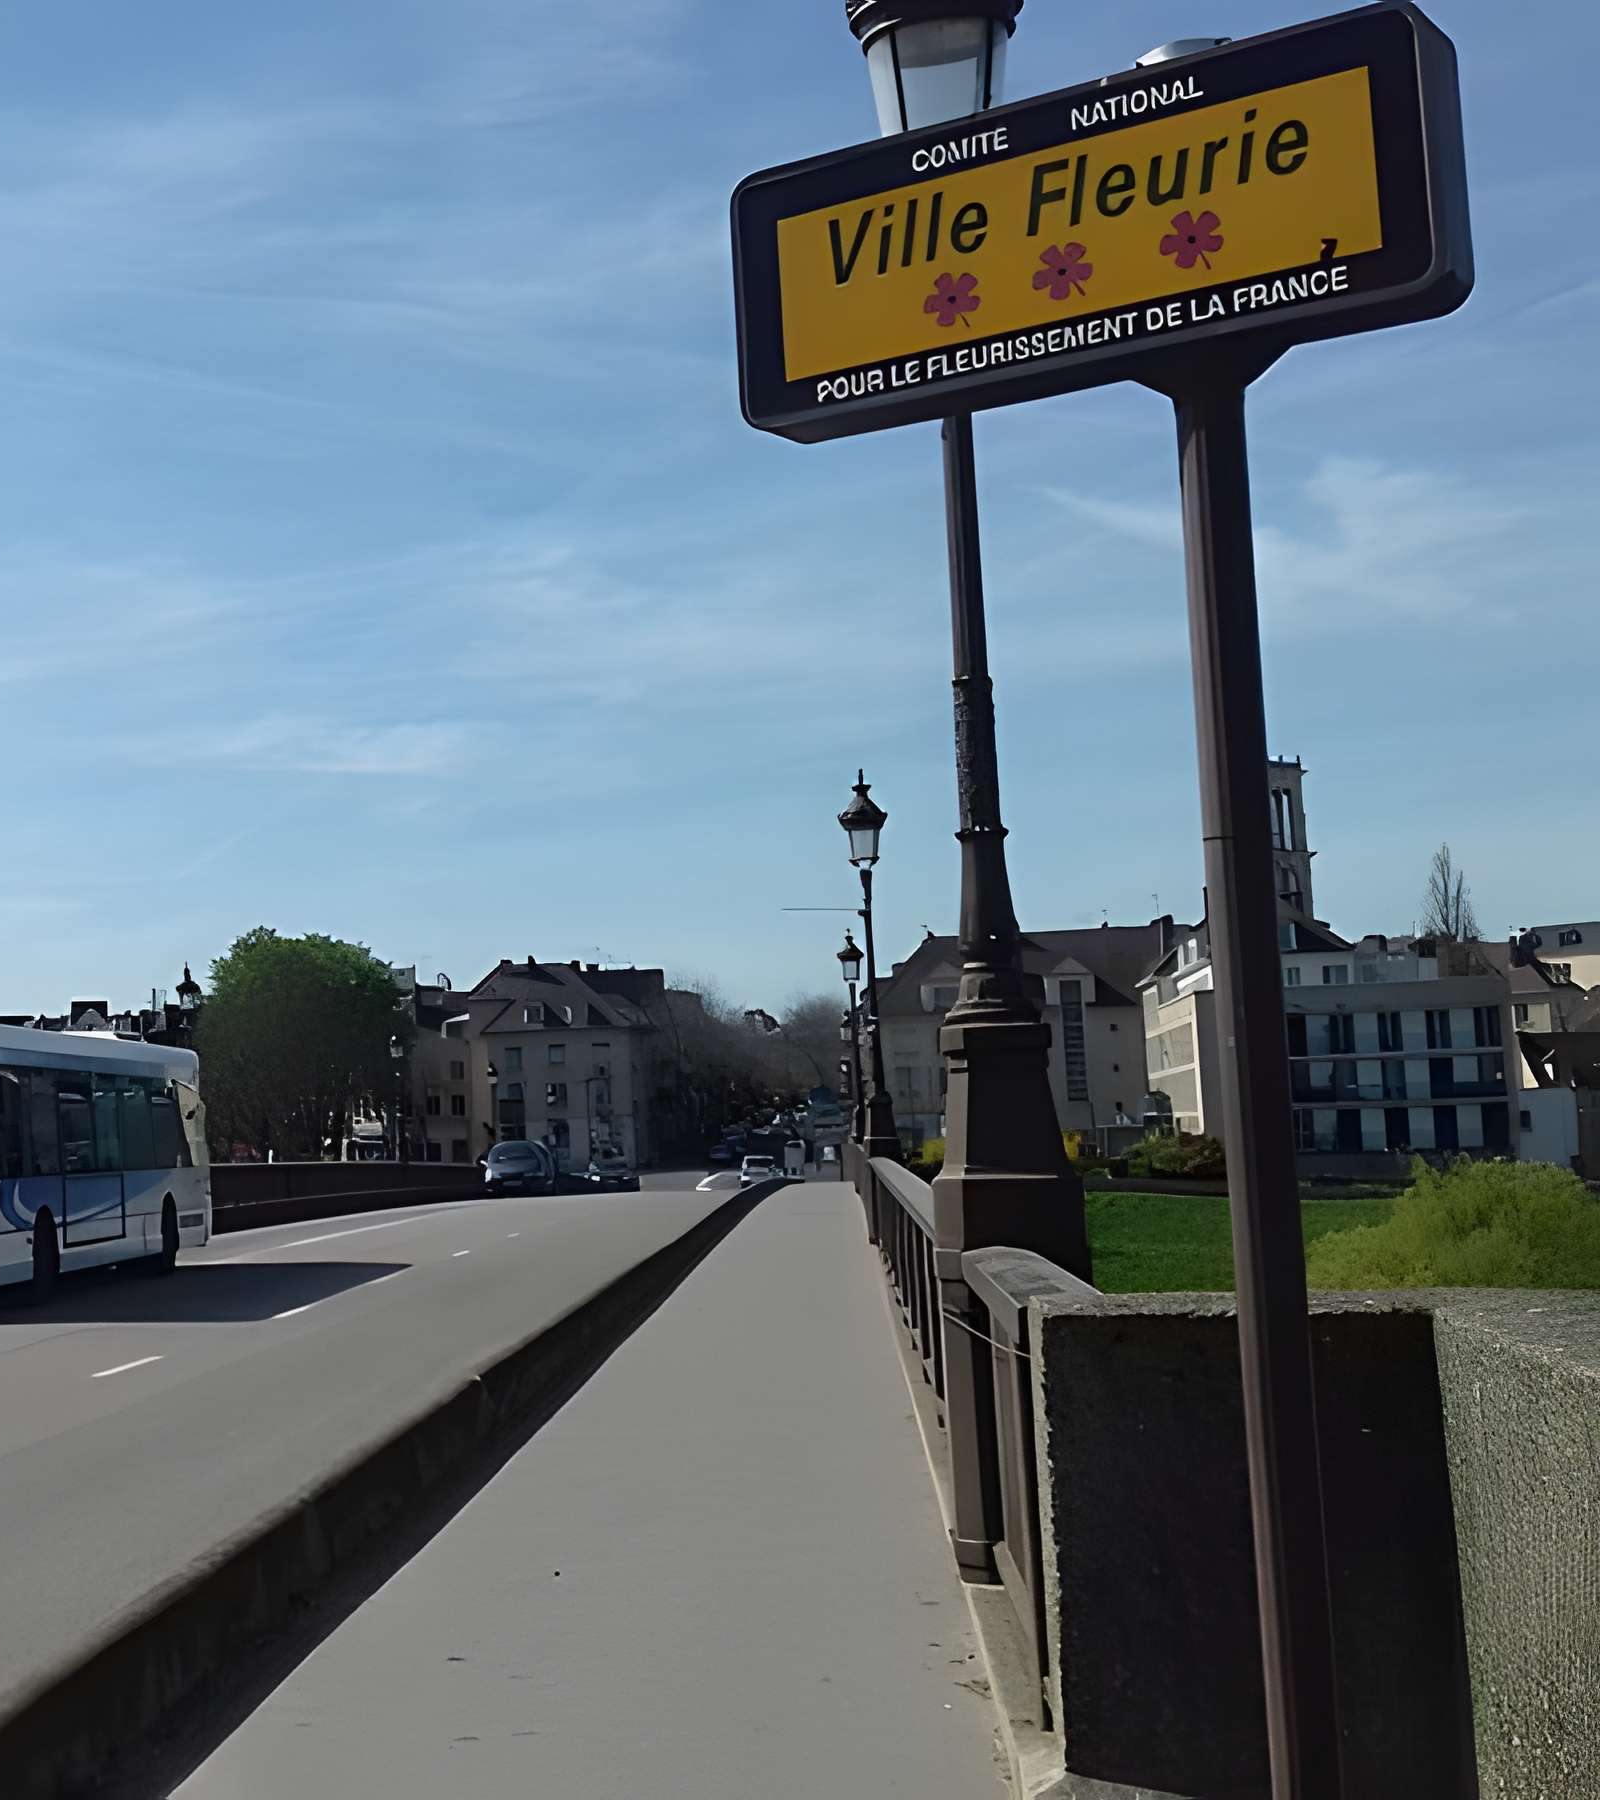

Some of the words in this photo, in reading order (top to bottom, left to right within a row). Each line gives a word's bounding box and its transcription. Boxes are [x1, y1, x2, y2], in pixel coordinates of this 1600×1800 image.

[1070, 76, 1204, 131] NATIONAL
[828, 191, 989, 287] Ville
[1026, 108, 1309, 237] Fleurie
[817, 368, 885, 403] POUR
[891, 360, 921, 388] LE
[927, 312, 1138, 380] FLEURISSEMENT
[1146, 302, 1183, 331] DE
[1191, 294, 1225, 321] LA
[1233, 265, 1349, 312] FRANCE
